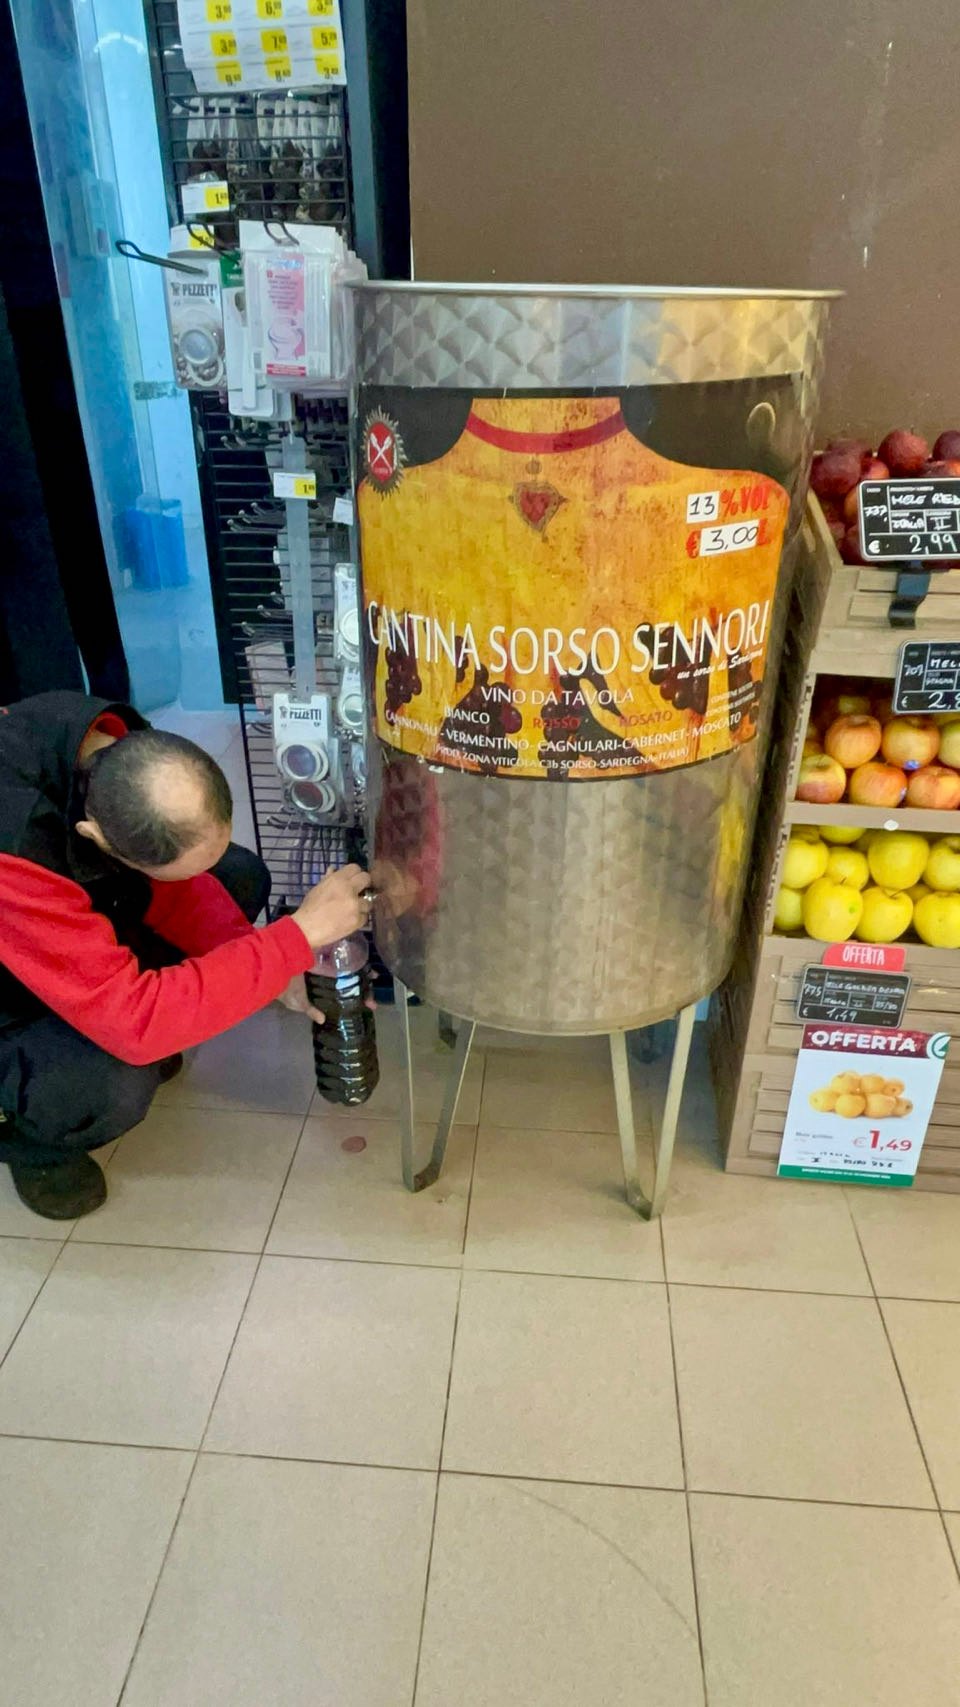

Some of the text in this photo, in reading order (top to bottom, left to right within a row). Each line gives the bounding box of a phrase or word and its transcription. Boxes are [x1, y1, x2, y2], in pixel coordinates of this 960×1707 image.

[690, 496, 715, 515] 13
[705, 526, 759, 551] 3,00
[909, 534, 957, 554] 2,99
[368, 600, 770, 676] CANTINA SORSO SENNORI
[931, 658, 960, 668] MEL
[481, 686, 634, 705] VINO DA TAVOLA
[444, 707, 673, 729] BIANCO ROSSO ROSATO
[445, 728, 529, 750] VERMENTINO
[463, 751, 491, 764] ZONA
[843, 945, 885, 965] OFFERTA
[827, 1007, 857, 1021] 1,49
[811, 1030, 916, 1052] OFFERTA
